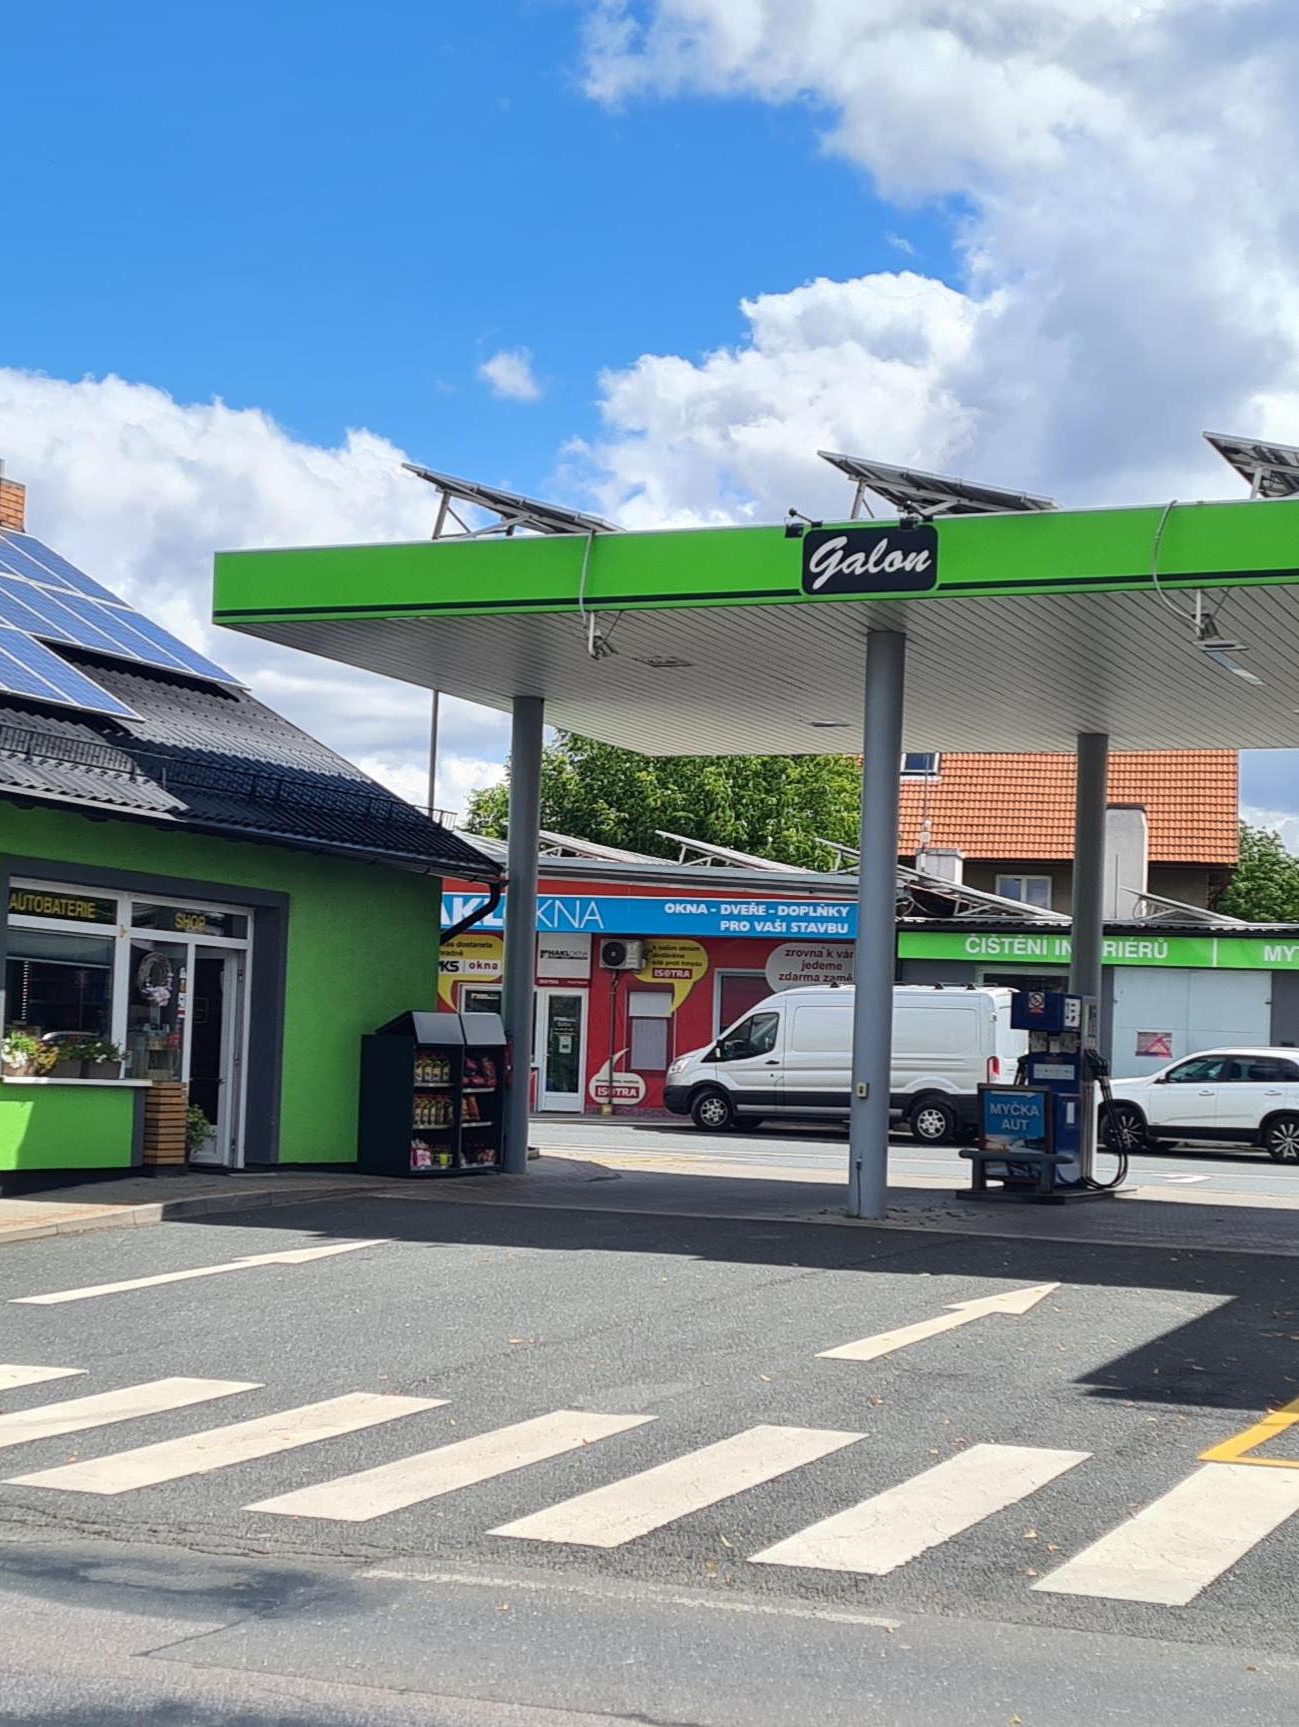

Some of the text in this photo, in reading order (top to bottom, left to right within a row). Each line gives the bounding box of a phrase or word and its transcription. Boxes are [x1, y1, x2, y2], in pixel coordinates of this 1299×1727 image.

[809, 535, 932, 590] Galon
[8, 892, 98, 919] AUTOBATERIE
[664, 902, 709, 915] OKNA
[720, 902, 767, 917] DVEŘE
[777, 904, 850, 918] DOPLŇKY
[174, 913, 207, 931] SHOP
[720, 920, 849, 935] PRO VAŠI STAVBU
[785, 949, 824, 958] zrovna
[826, 948, 835, 958] k
[965, 935, 1168, 960] ČIŠTĚNÍ INRIÉRŮ
[468, 960, 499, 971] okna
[801, 960, 843, 972] jedeme
[778, 972, 819, 982] zdarma
[598, 1087, 637, 1097] ISTRA
[990, 1099, 1040, 1117] MYČKA
[1001, 1119, 1029, 1131] AUT
